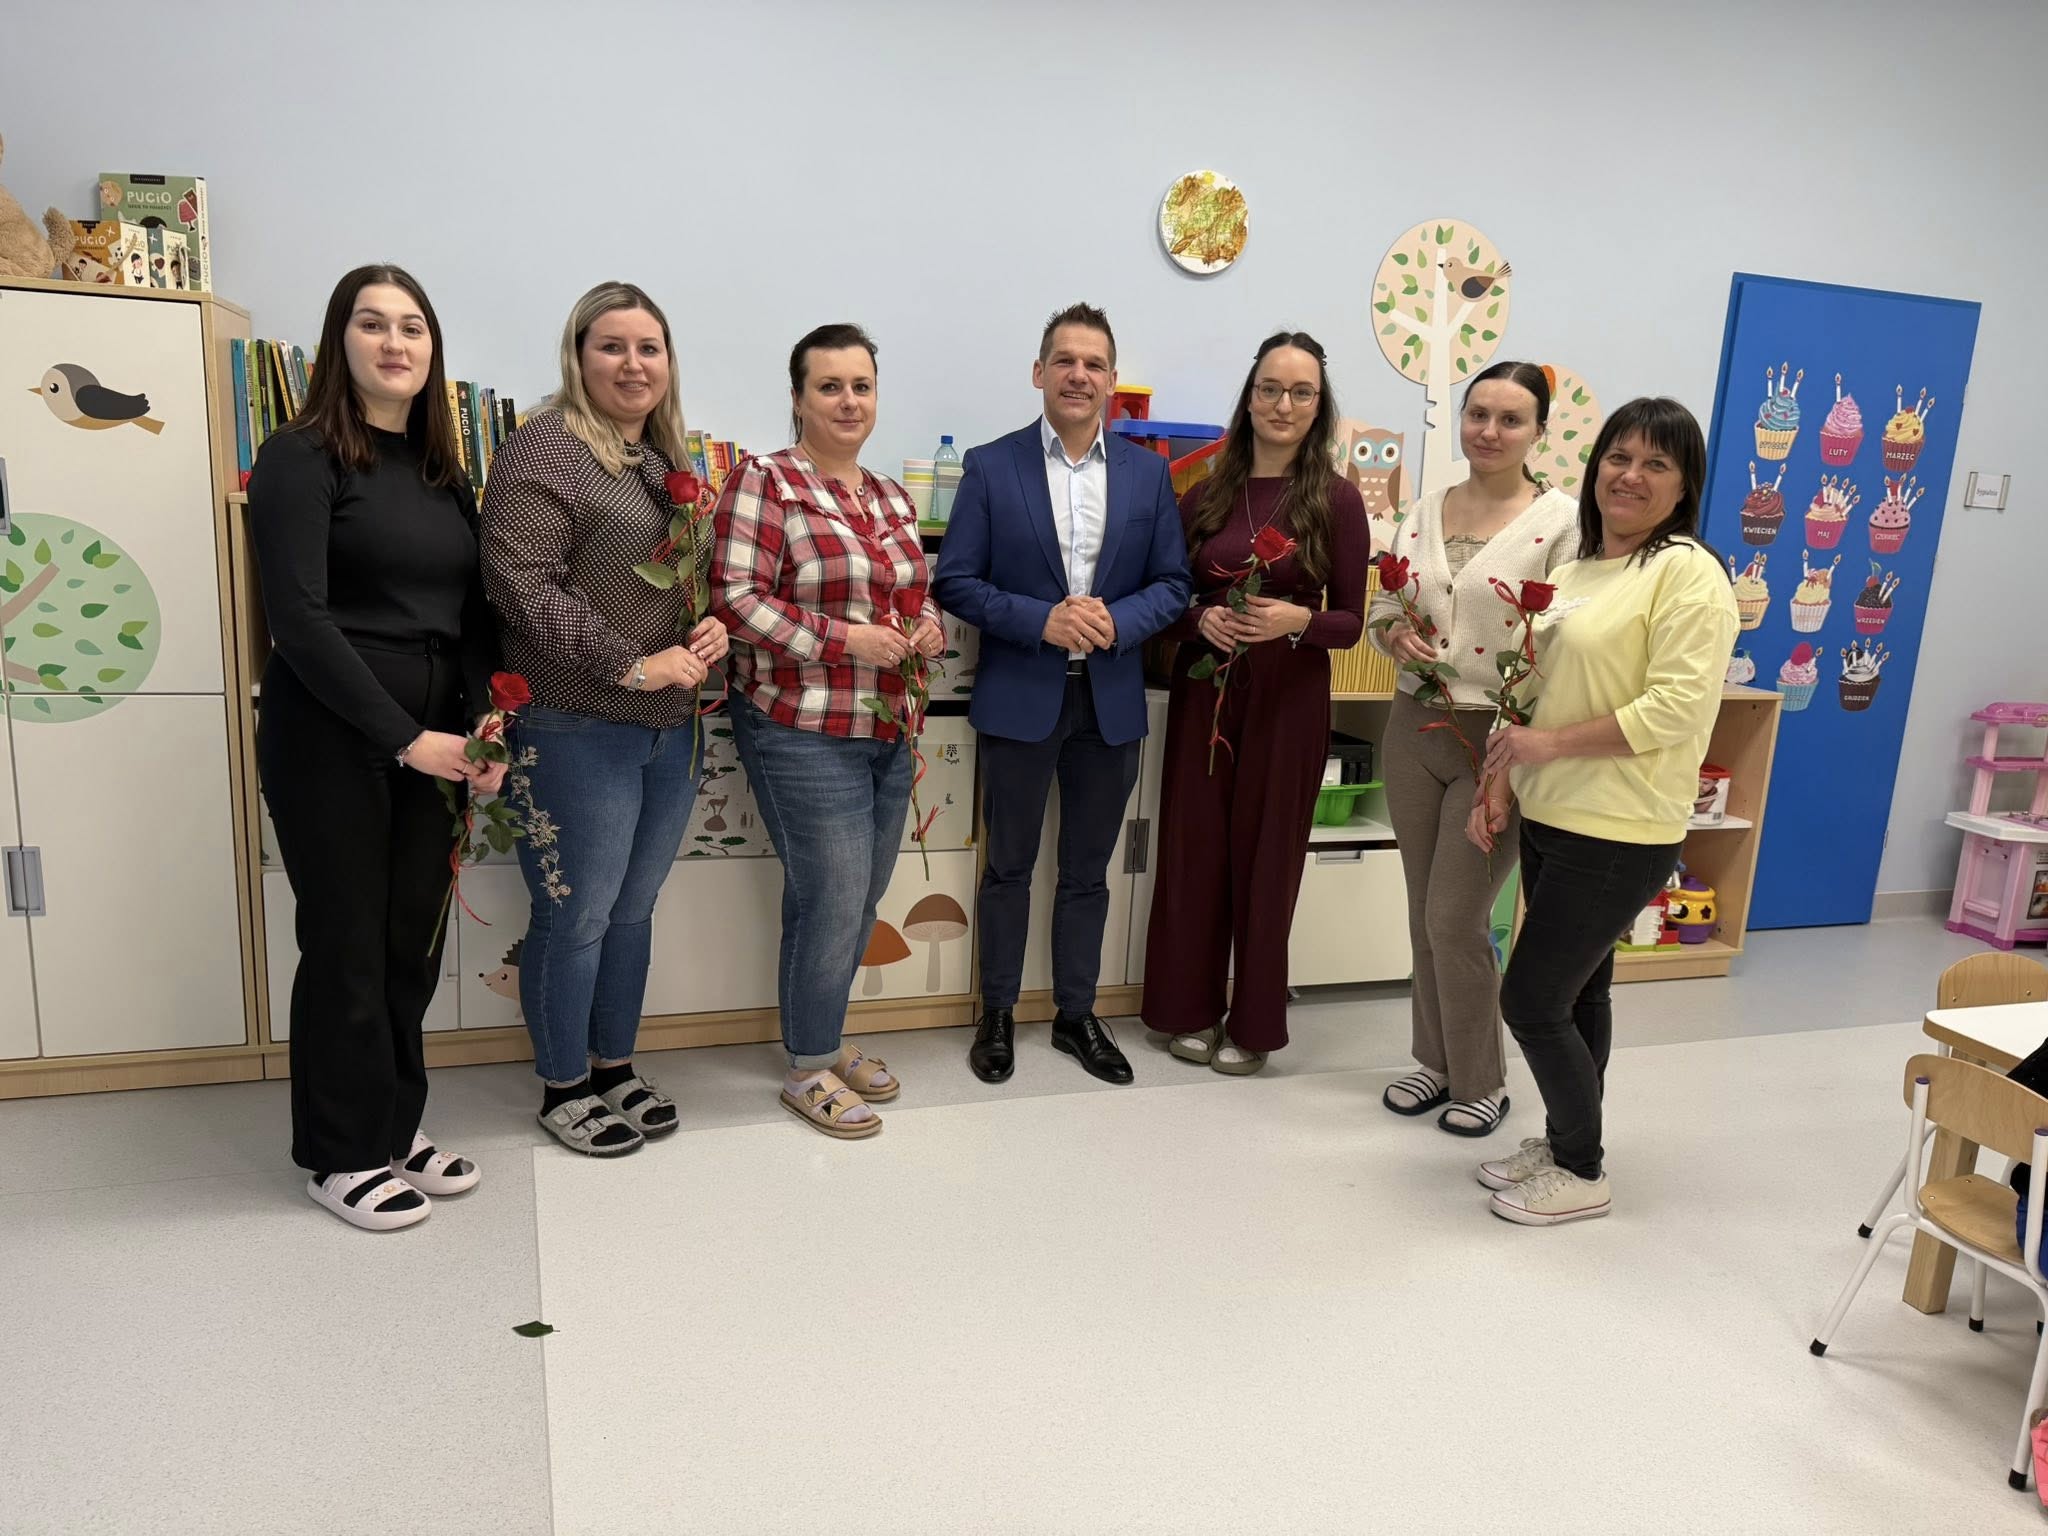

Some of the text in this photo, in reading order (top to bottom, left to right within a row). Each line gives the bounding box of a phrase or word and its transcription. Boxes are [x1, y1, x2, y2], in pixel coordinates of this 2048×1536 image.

[1829, 448, 1848, 457] LUTY
[1886, 452, 1915, 461] MARZEC
[1817, 530, 1830, 538] MAJ
